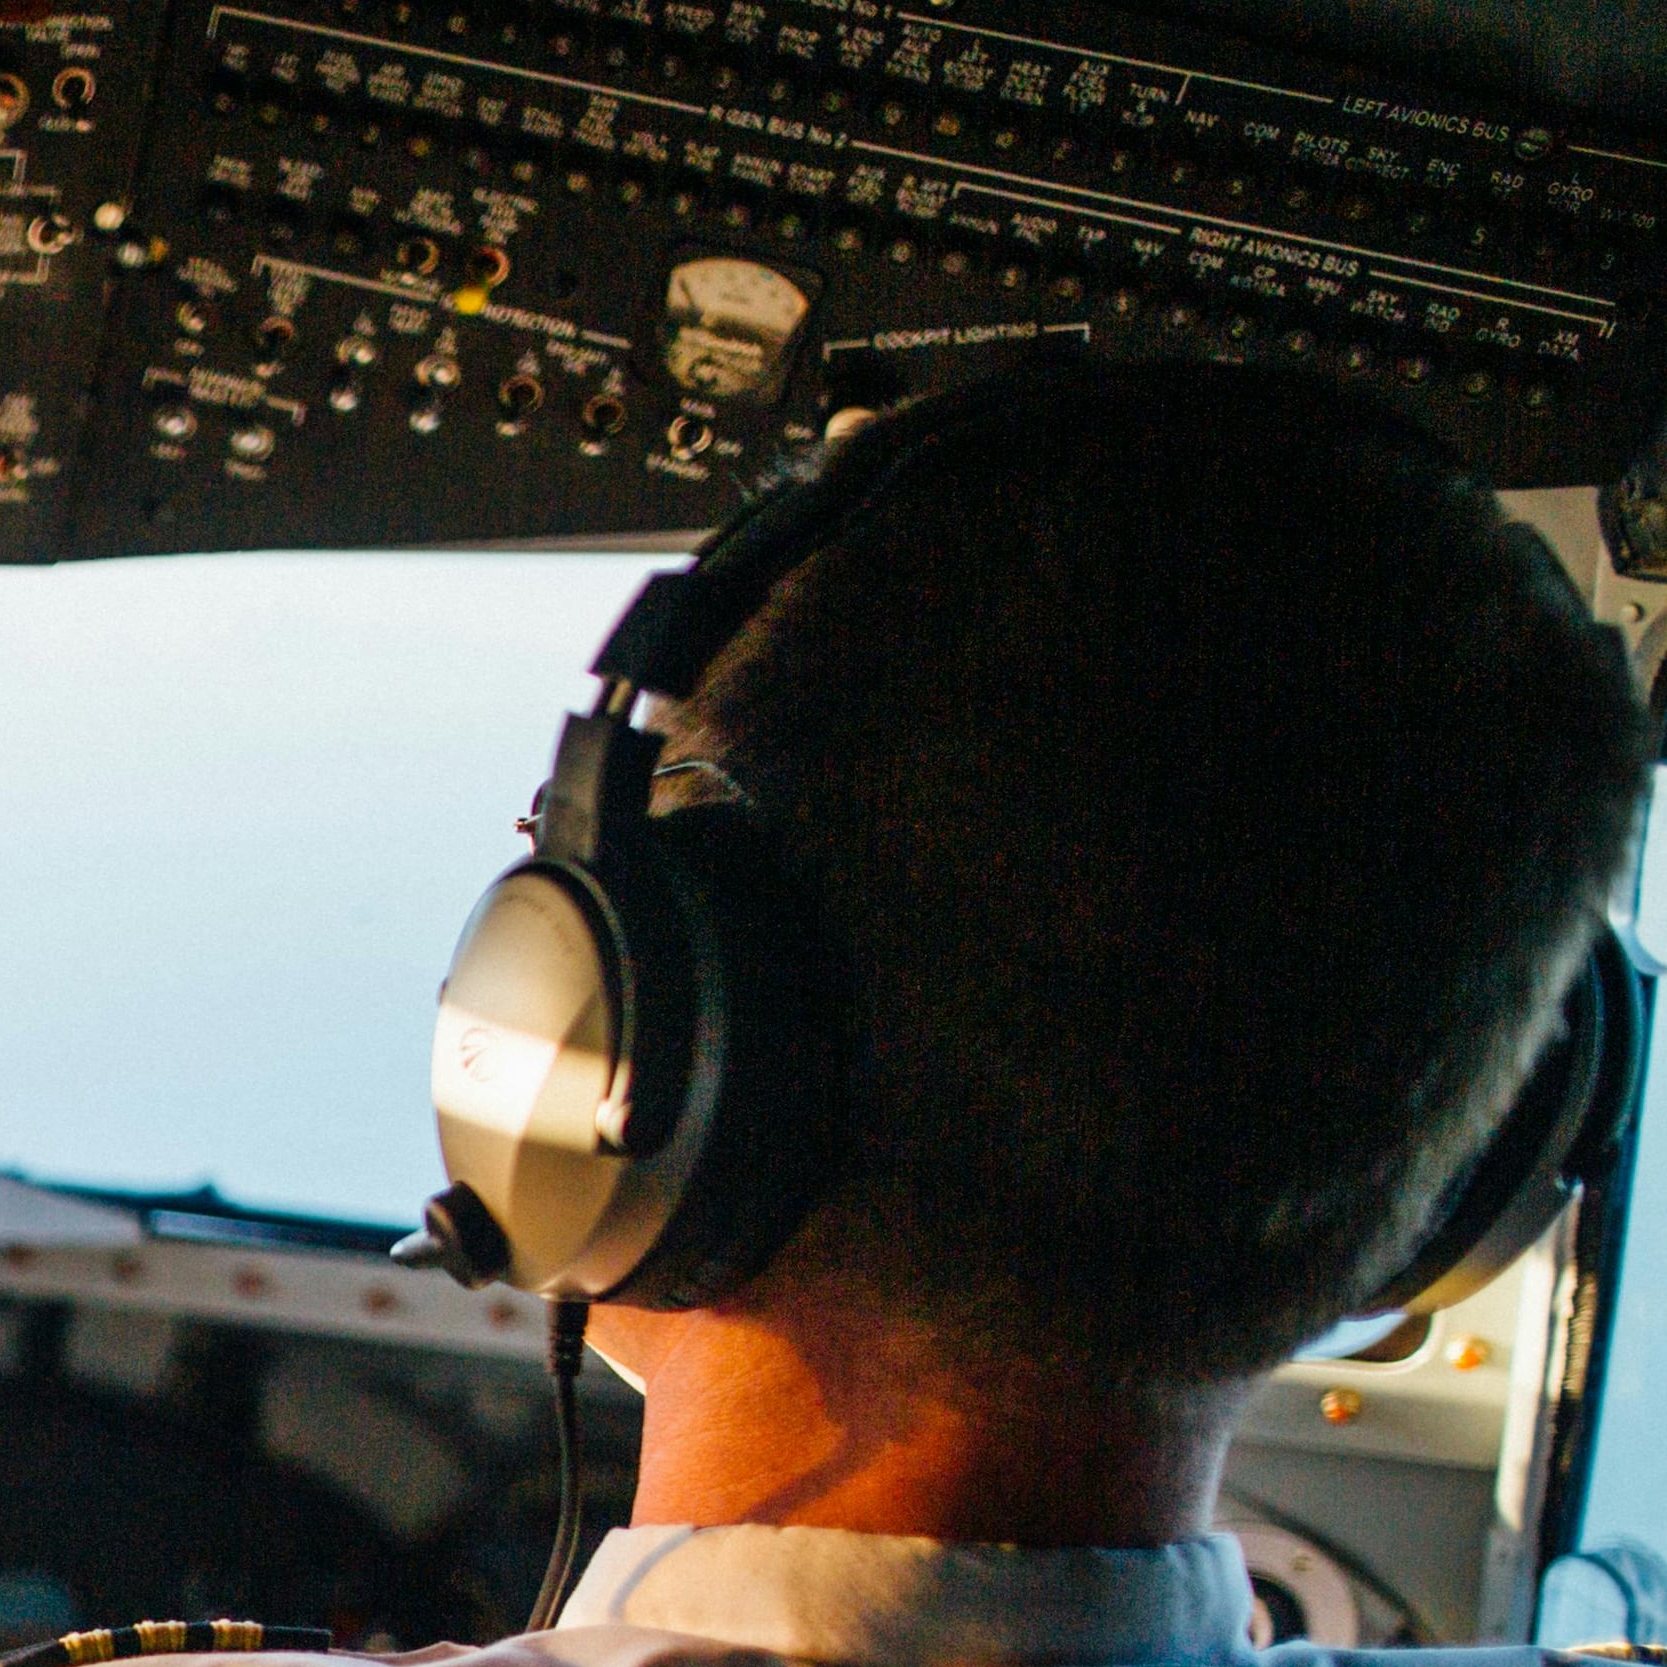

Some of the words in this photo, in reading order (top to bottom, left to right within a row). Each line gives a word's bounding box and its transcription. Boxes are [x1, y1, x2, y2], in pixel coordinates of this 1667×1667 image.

[1129, 82, 1169, 103] TURN
[1183, 109, 1220, 128] NAV
[1342, 95, 1387, 118] LEFT
[1386, 105, 1470, 135] AVIONICS
[1471, 123, 1510, 143] BUS
[1243, 121, 1281, 141] COM
[1293, 130, 1350, 155] PILOTS
[1367, 144, 1401, 164] SKY
[1489, 170, 1525, 190] RAD
[1547, 180, 1594, 203] GYRO
[1188, 226, 1243, 252] RIGHT
[1241, 239, 1321, 270] AVIONICS
[1321, 255, 1360, 278] BUS
[1475, 326, 1522, 349] GYRO
